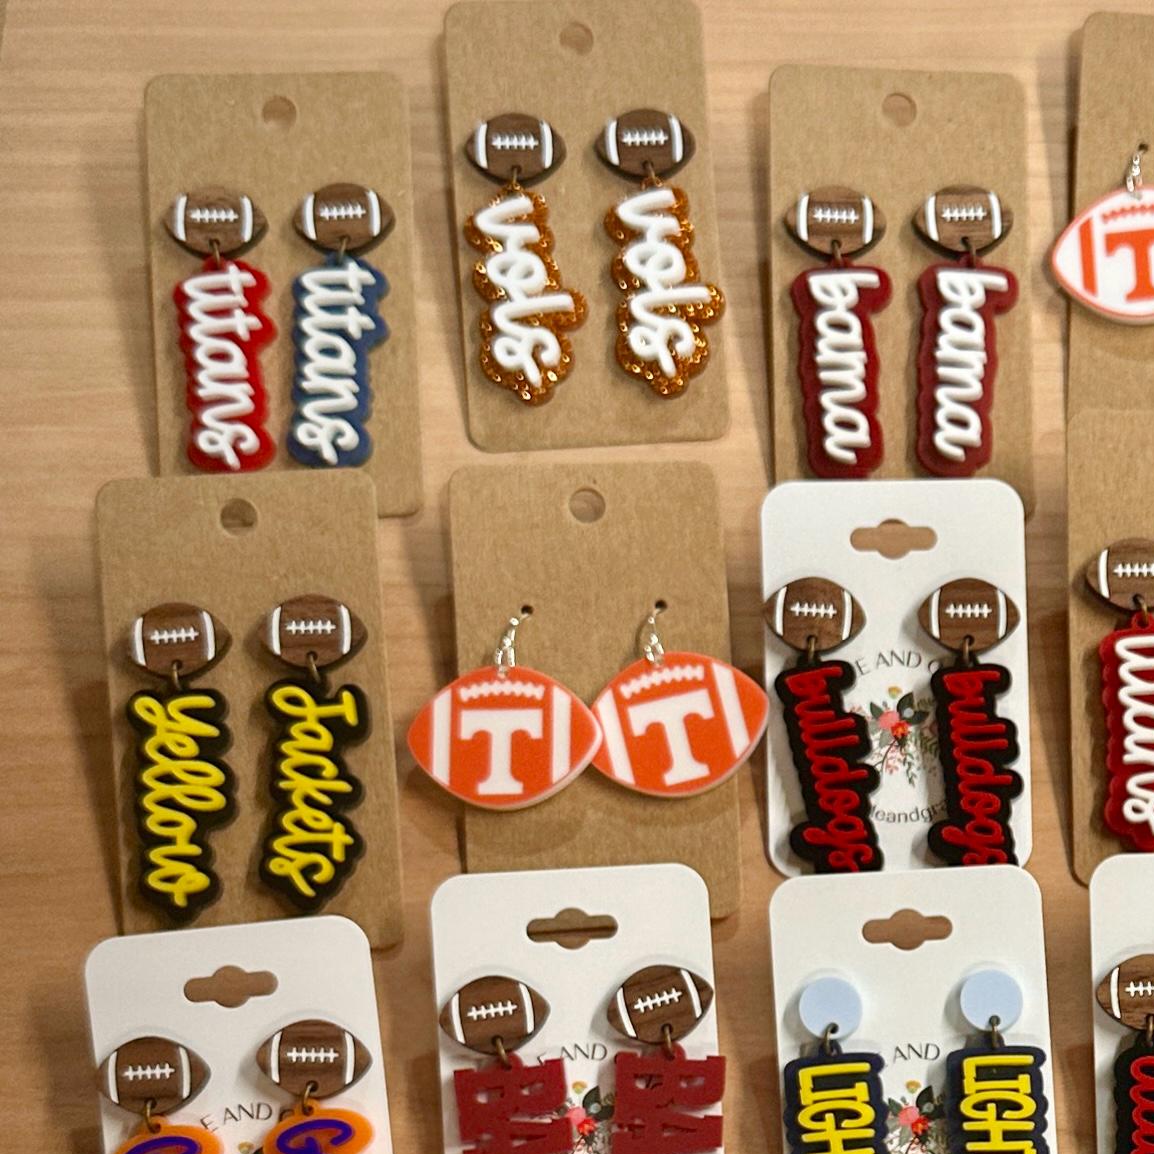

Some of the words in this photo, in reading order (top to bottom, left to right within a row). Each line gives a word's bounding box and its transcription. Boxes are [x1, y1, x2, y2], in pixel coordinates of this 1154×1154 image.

[181, 262, 262, 470] titans
[296, 260, 376, 466] titans
[474, 196, 576, 387] vols
[616, 188, 711, 379] vols
[808, 271, 881, 466] bama
[934, 269, 1009, 462] bama
[459, 708, 544, 797] T
[626, 689, 715, 787] T
[876, 650, 922, 669] AND
[134, 694, 227, 908] Yellow
[267, 685, 358, 898] Jackets
[223, 1102, 274, 1126] AND
[558, 1042, 609, 1061] AND
[892, 1042, 941, 1062] AND
